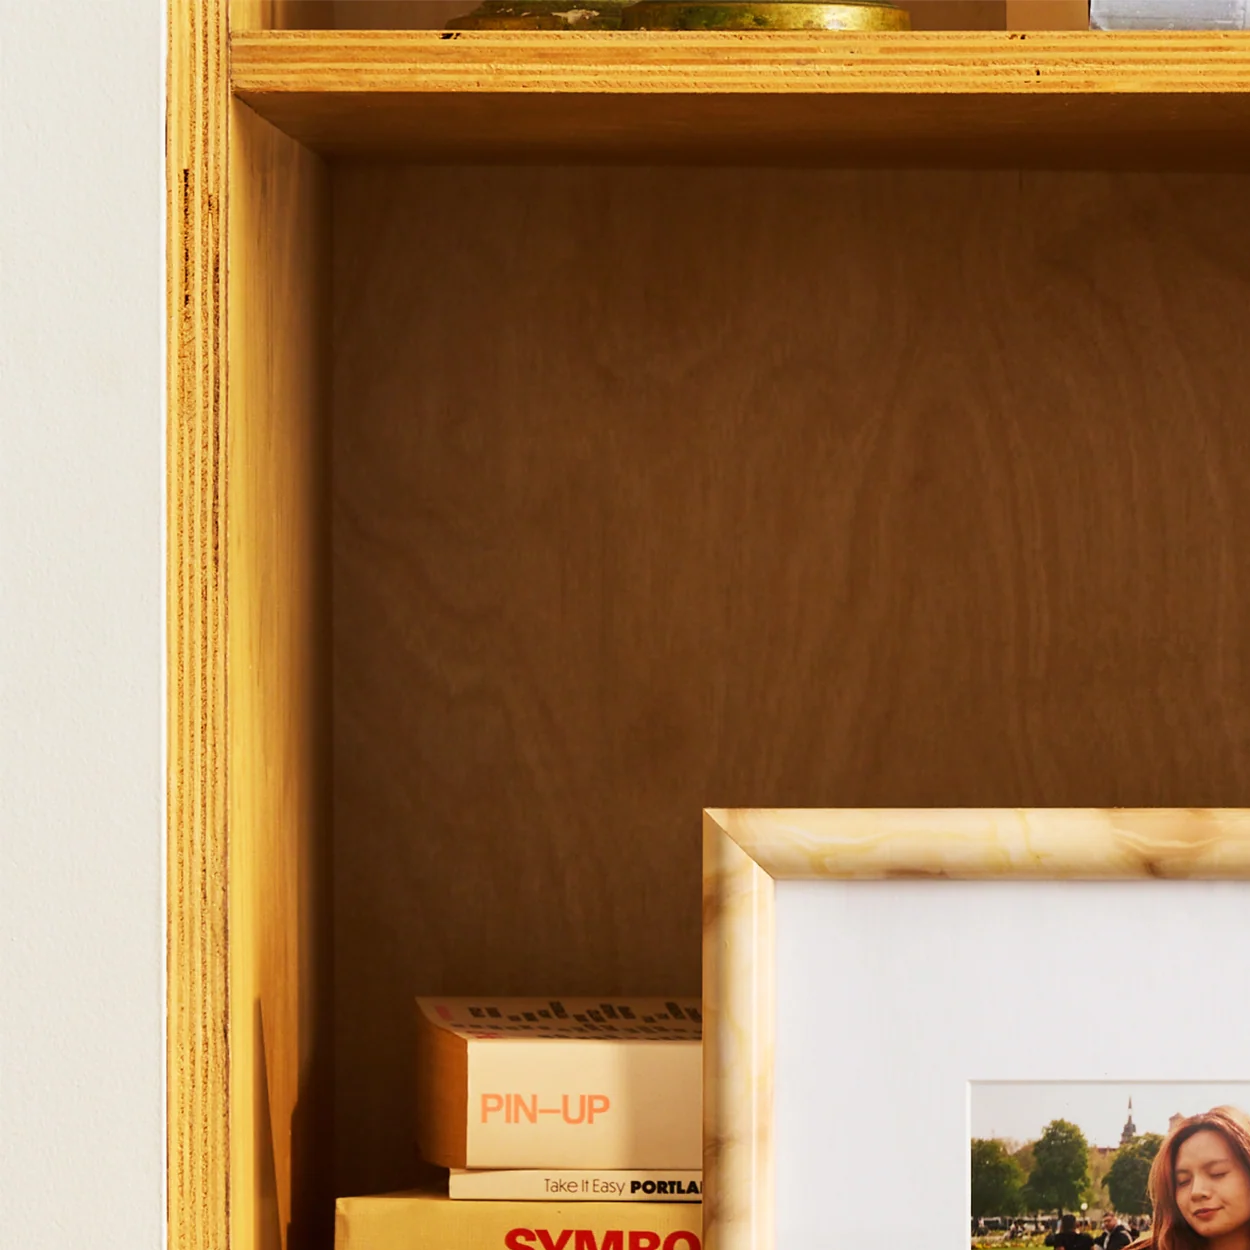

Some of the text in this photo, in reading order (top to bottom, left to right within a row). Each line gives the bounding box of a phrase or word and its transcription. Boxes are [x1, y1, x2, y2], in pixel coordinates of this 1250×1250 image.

[544, 1179, 702, 1196] Take It Easy PORTLA
